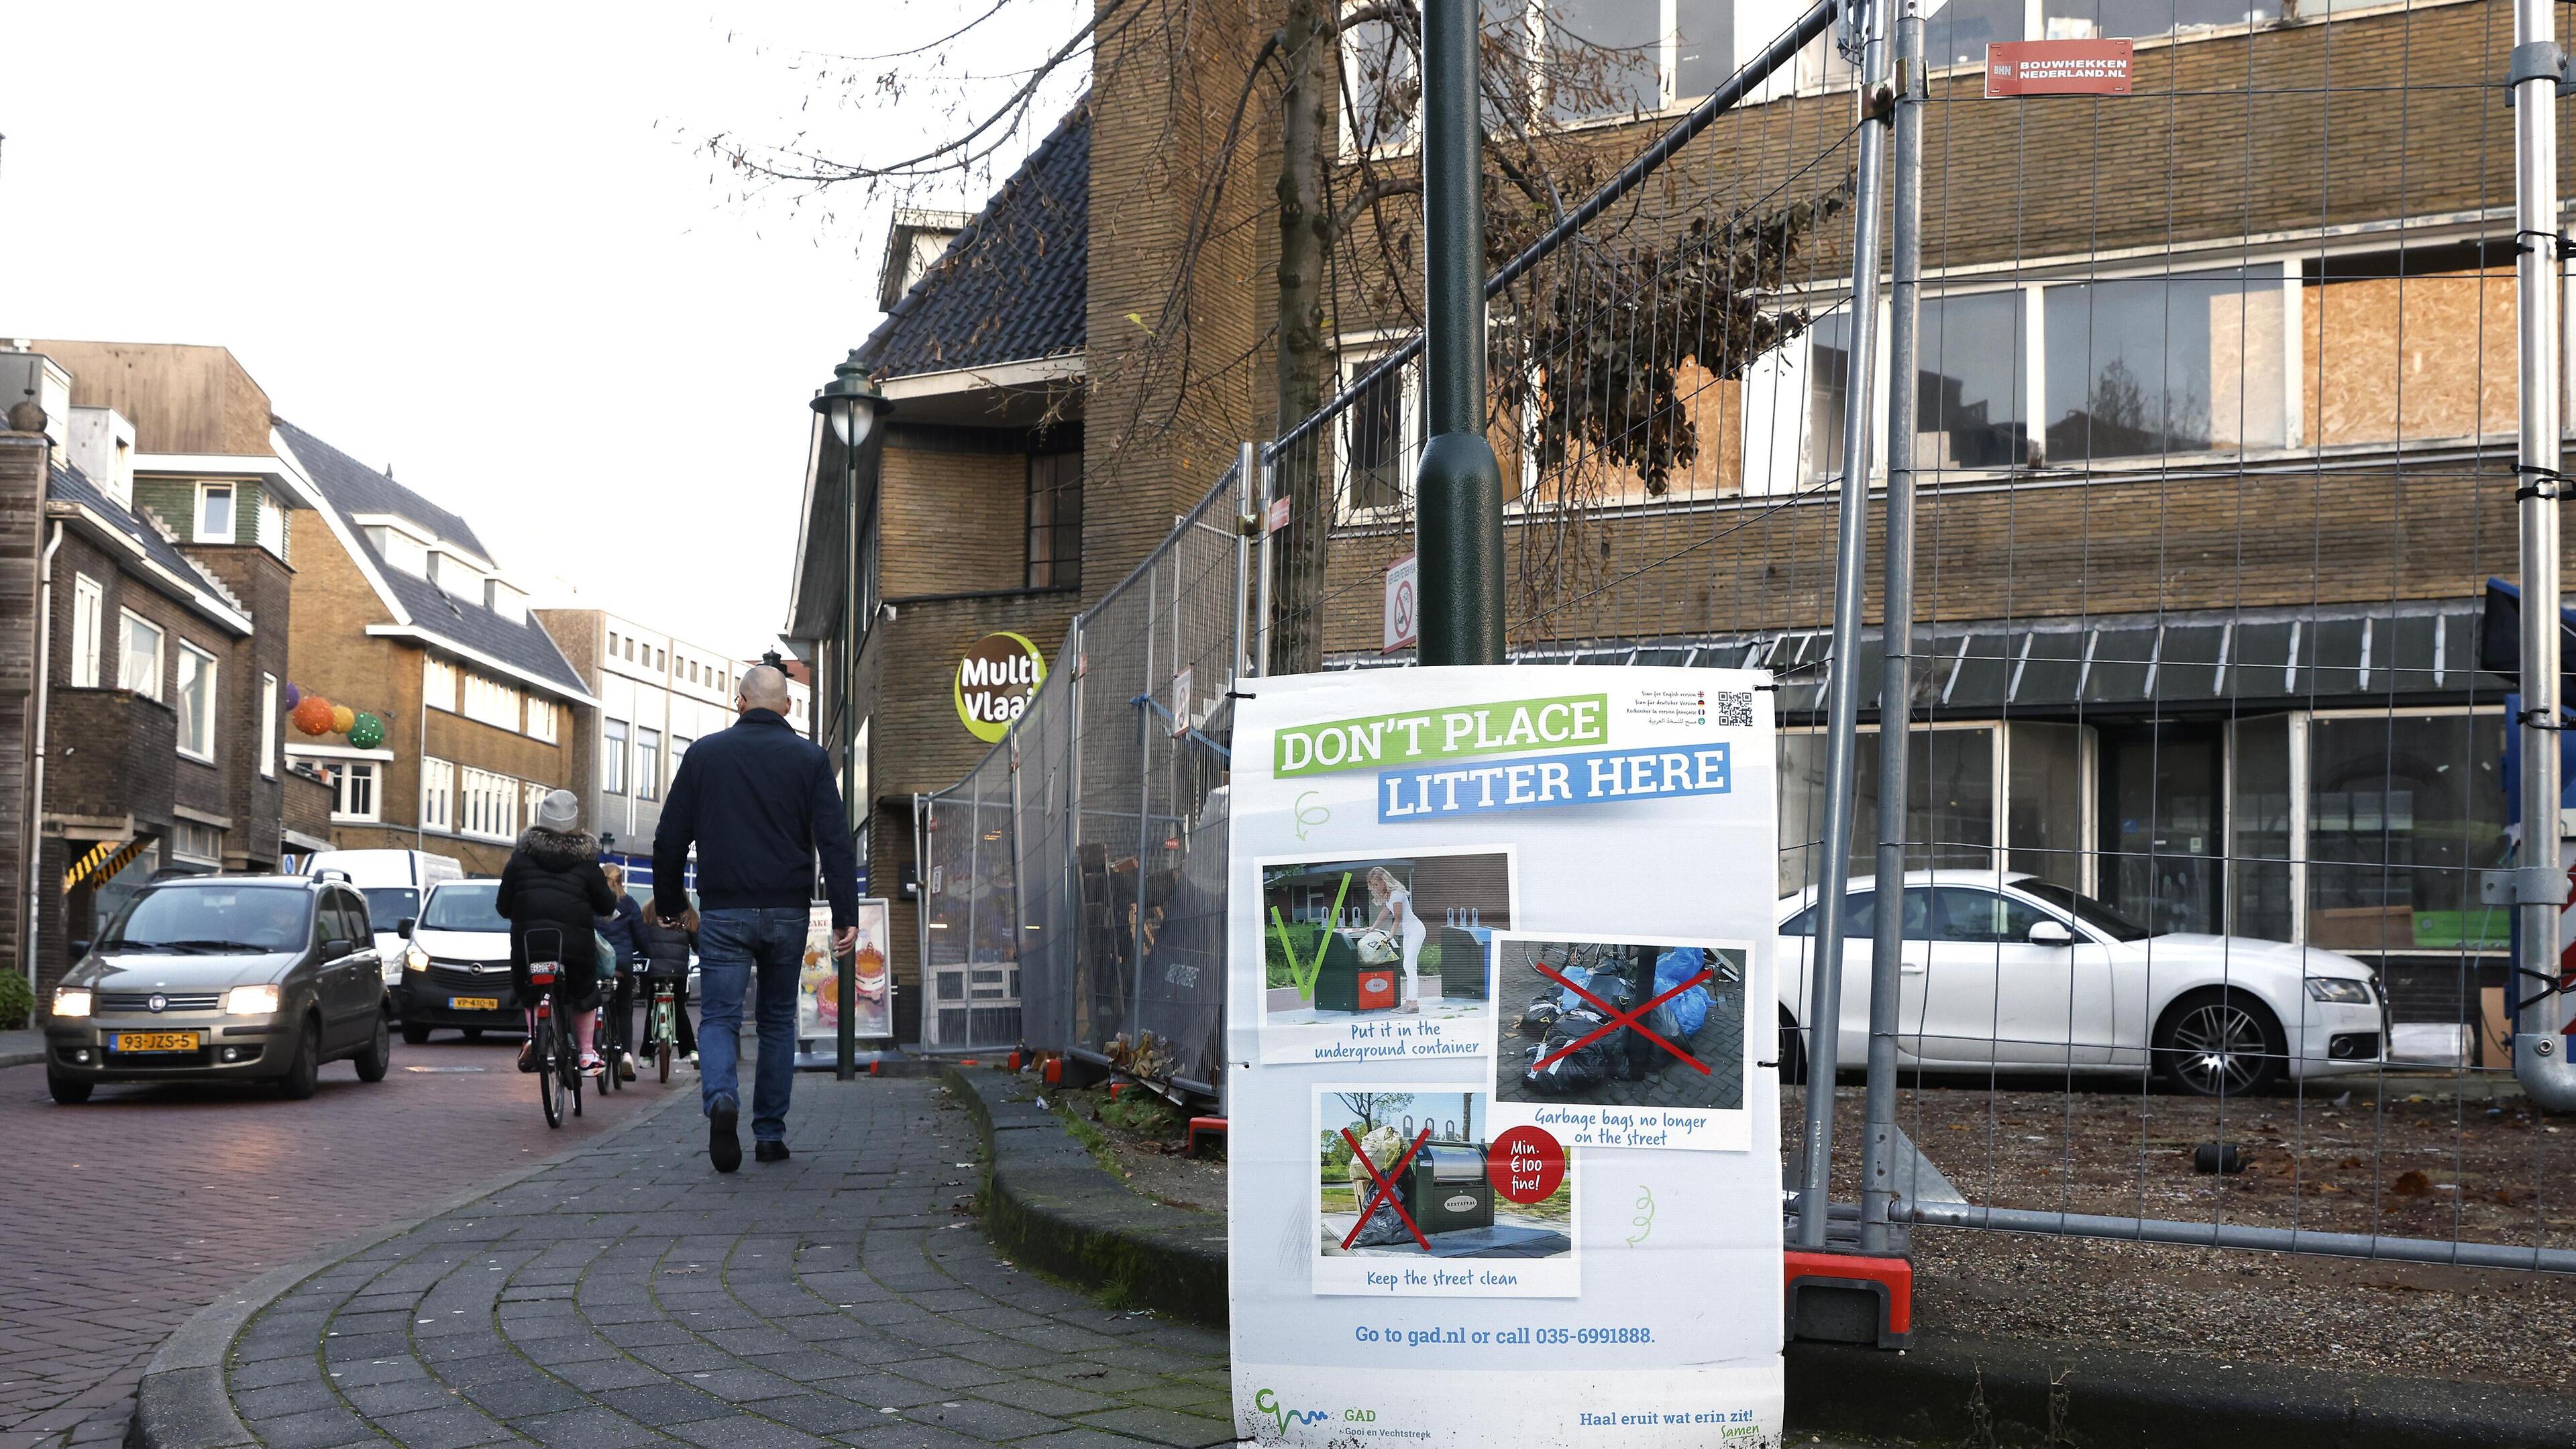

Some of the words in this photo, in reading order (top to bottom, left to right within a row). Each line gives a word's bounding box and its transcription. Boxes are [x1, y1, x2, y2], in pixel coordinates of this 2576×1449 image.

[2021, 60, 2126, 69] BOUWHEKKEN
[2021, 70, 2125, 78] NEDERLAND.NL
[962, 651, 1041, 687] Multi
[1281, 716, 1431, 771] DON'T
[1442, 700, 1601, 753] PLACE
[1386, 762, 1572, 816] LITTER
[1587, 750, 1725, 798] HERE
[1352, 1022, 1375, 1040] Put
[1381, 1022, 1391, 1036] it
[1398, 1023, 1411, 1036] in
[1418, 1020, 1440, 1035] the
[125, 1035, 190, 1049] 93-JZS-5
[1315, 1040, 1405, 1063] underground
[1412, 1039, 1479, 1054] container
[1535, 1108, 1596, 1129] Garbage
[1603, 1110, 1635, 1130] bags
[1641, 1116, 1657, 1126] no
[1663, 1114, 1707, 1132] longer
[1575, 1130, 1592, 1143] on
[1598, 1128, 1621, 1144] the
[1627, 1129, 1668, 1146] street
[1511, 1140, 1539, 1156] Min.
[1510, 1158, 1542, 1173] €100
[1511, 1175, 1540, 1195] fine!
[1367, 1271, 1398, 1290] Keep
[1404, 1269, 1427, 1285] the
[1434, 1271, 1474, 1286] street
[1481, 1271, 1517, 1285] clean
[1356, 1326, 1379, 1341] Go
[1385, 1328, 1401, 1342] to
[1408, 1327, 1466, 1346] gad.nl
[1472, 1332, 1490, 1343] or
[1497, 1328, 1530, 1344] call
[1536, 1328, 1655, 1344] 035-6991888.
[1344, 1409, 1376, 1421] GAD
[1580, 1412, 1616, 1425] Haal
[1621, 1412, 1658, 1424] eruit
[1663, 1413, 1691, 1424] wat
[1695, 1411, 1725, 1423] erin
[1731, 1409, 1752, 1421] zit!
[1345, 1427, 1364, 1436] Gooi
[1379, 1429, 1432, 1438] Vechtstreek
[1721, 1424, 1760, 1439] Samen
